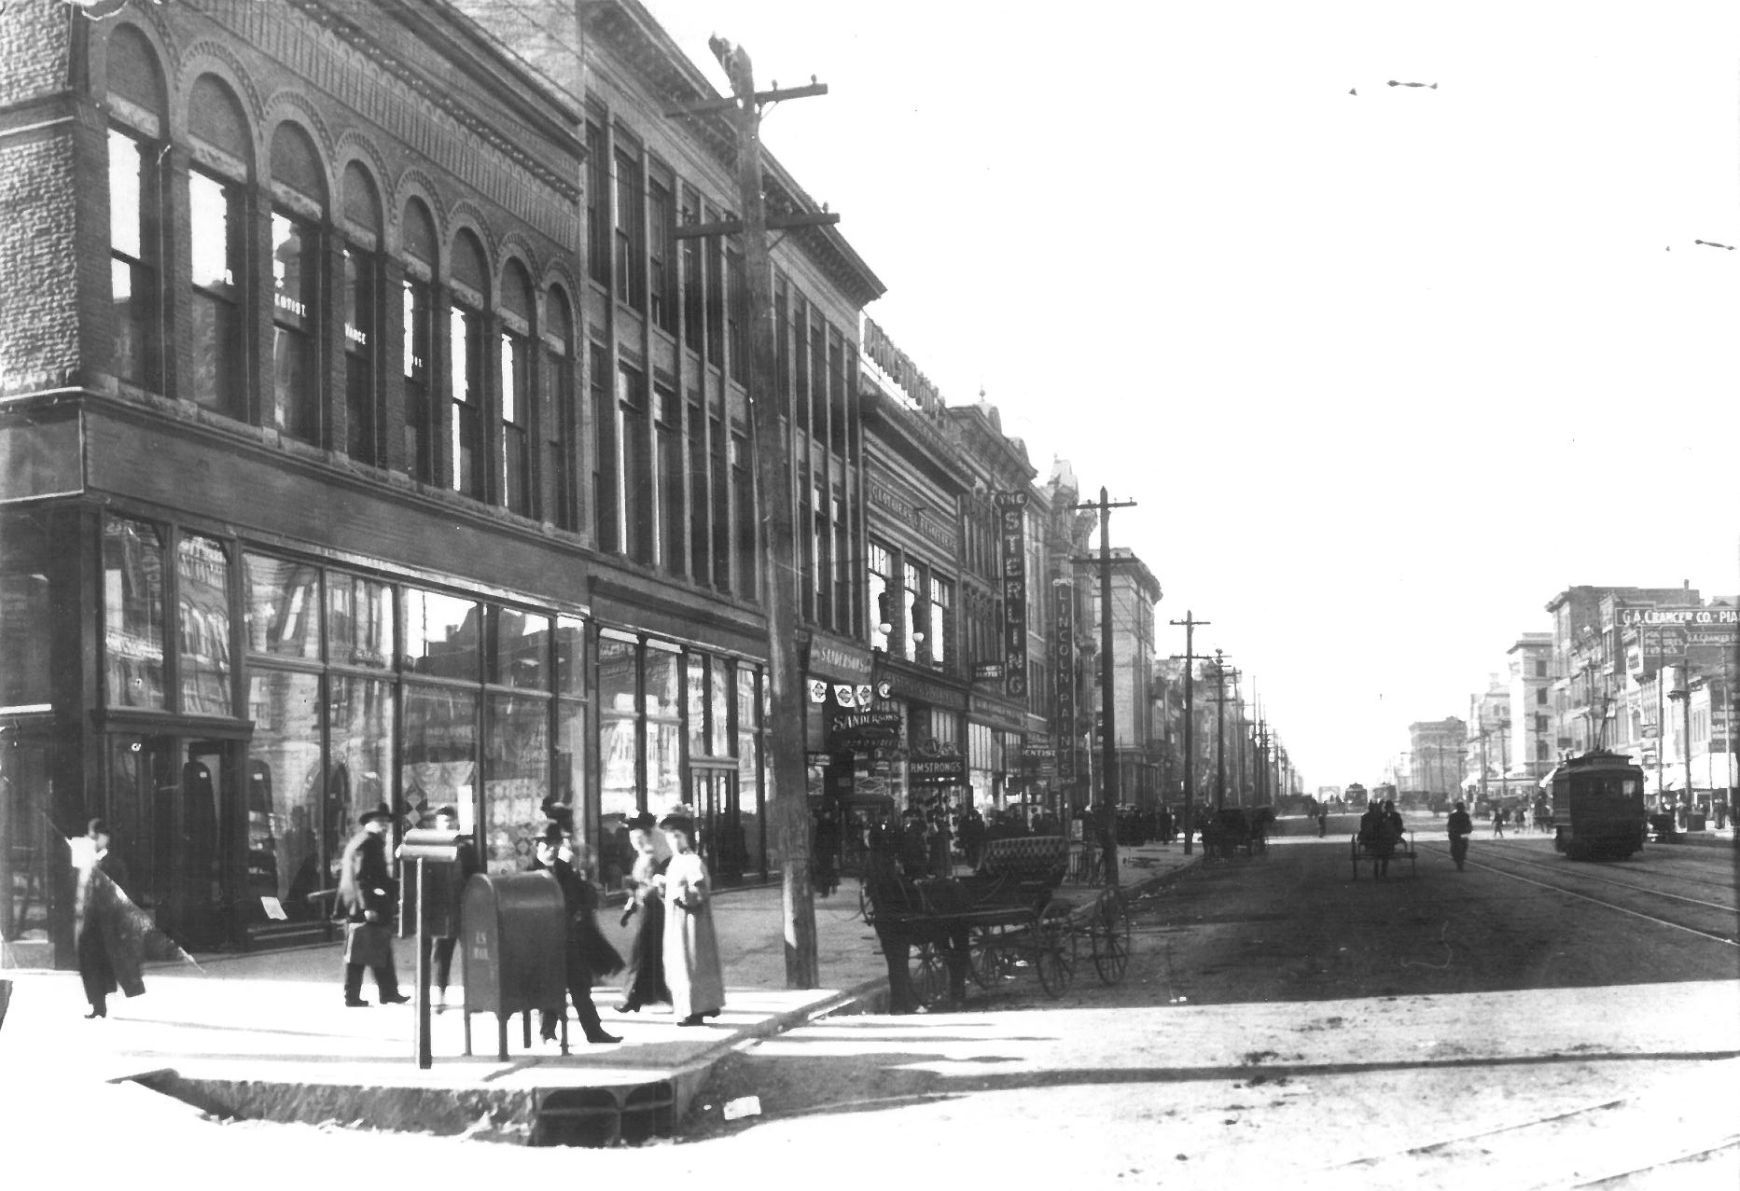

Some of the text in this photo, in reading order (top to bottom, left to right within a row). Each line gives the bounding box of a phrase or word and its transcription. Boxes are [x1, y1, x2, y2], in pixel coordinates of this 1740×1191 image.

[1001, 493, 1025, 505] THE
[1004, 511, 1024, 694] STERLING
[1058, 589, 1071, 776] LINCOLN PAINTS
